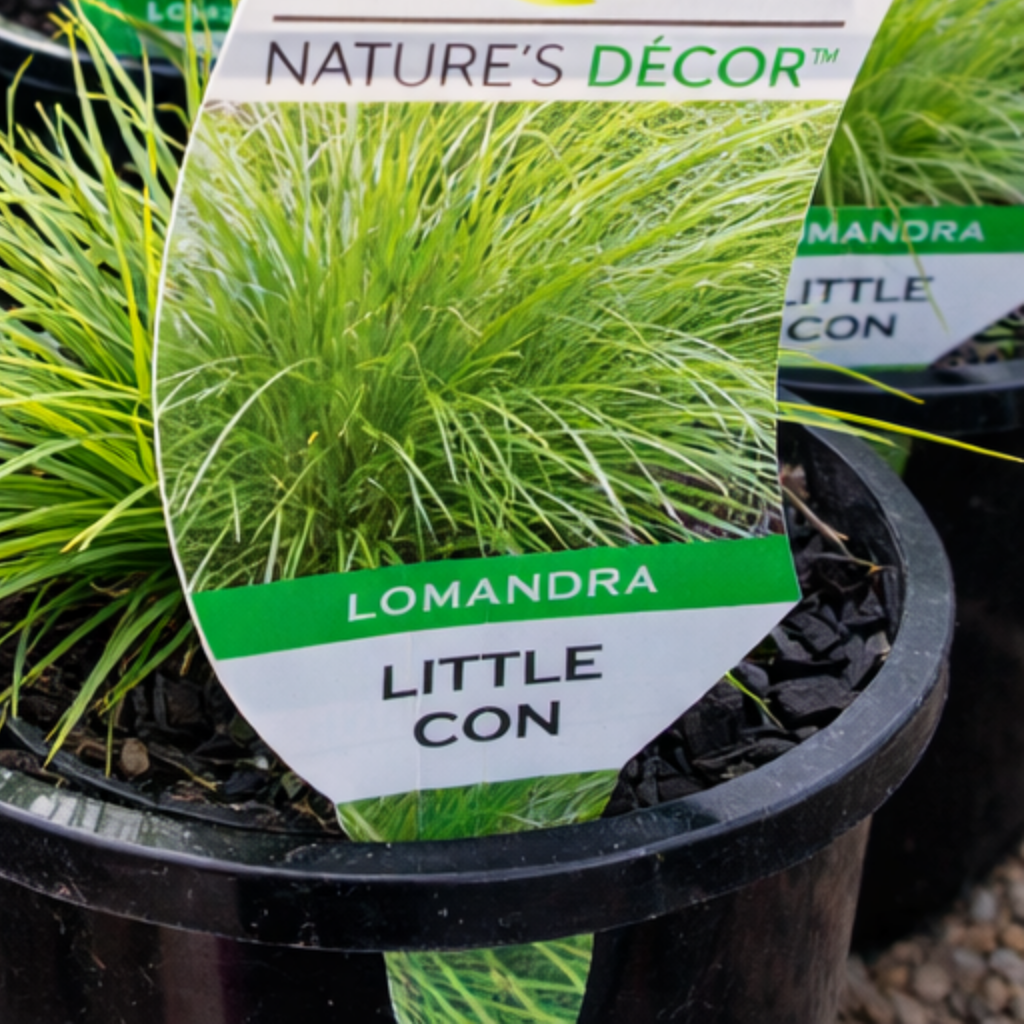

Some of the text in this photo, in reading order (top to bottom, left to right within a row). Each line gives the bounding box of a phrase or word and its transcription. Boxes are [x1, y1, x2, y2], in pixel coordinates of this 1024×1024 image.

[265, 40, 564, 87] NATURE'S
[807, 219, 985, 245] MANDRA
[787, 313, 896, 342] CON
[347, 564, 658, 622] LOMANDRA
[382, 643, 603, 701] LITTLE
[413, 700, 561, 748] CON
